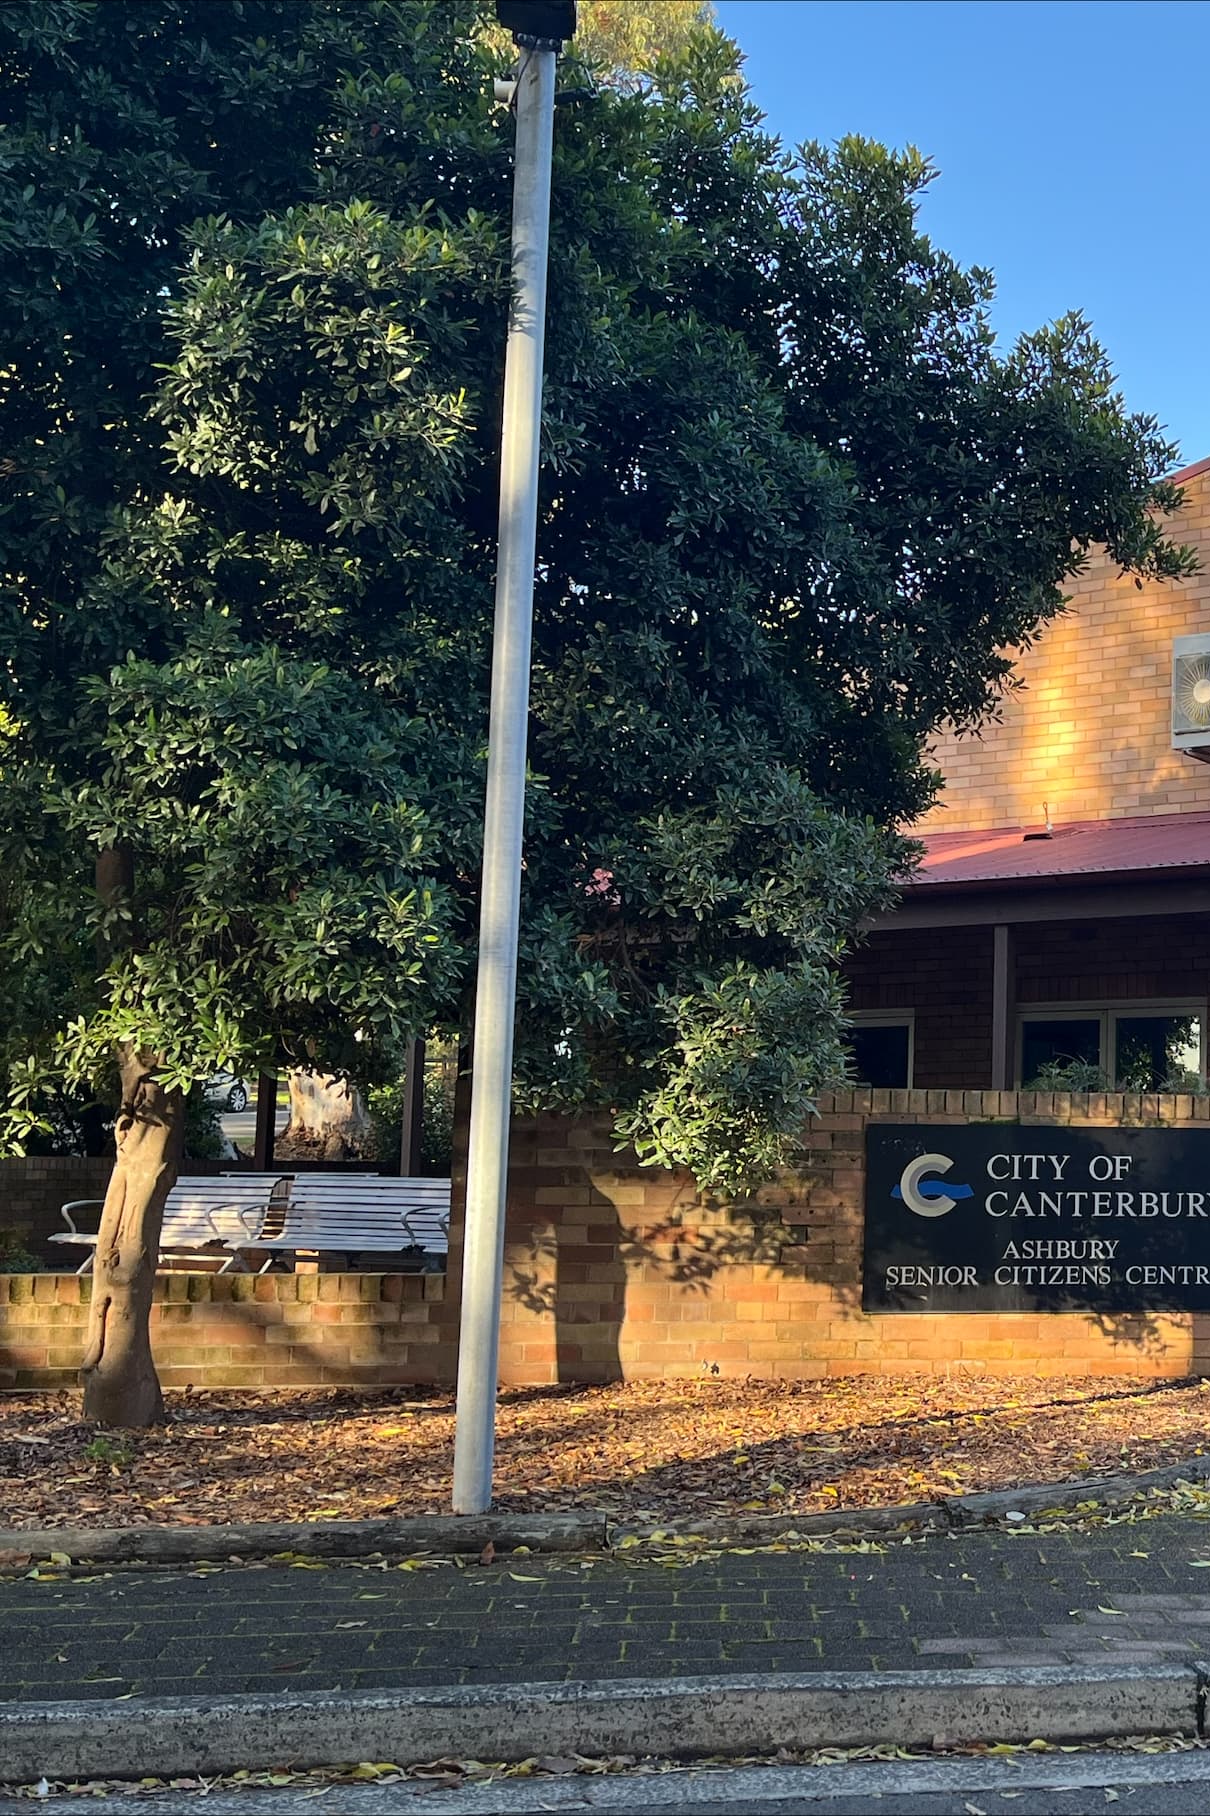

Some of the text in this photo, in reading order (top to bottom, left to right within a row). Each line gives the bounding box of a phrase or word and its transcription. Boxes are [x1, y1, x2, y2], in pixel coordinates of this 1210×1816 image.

[986, 1153, 1133, 1181] CITY OF
[1001, 1239, 1120, 1260] ASHBURY
[885, 1265, 979, 1286] SENIOR
[993, 1265, 1112, 1286] CITIZENS
